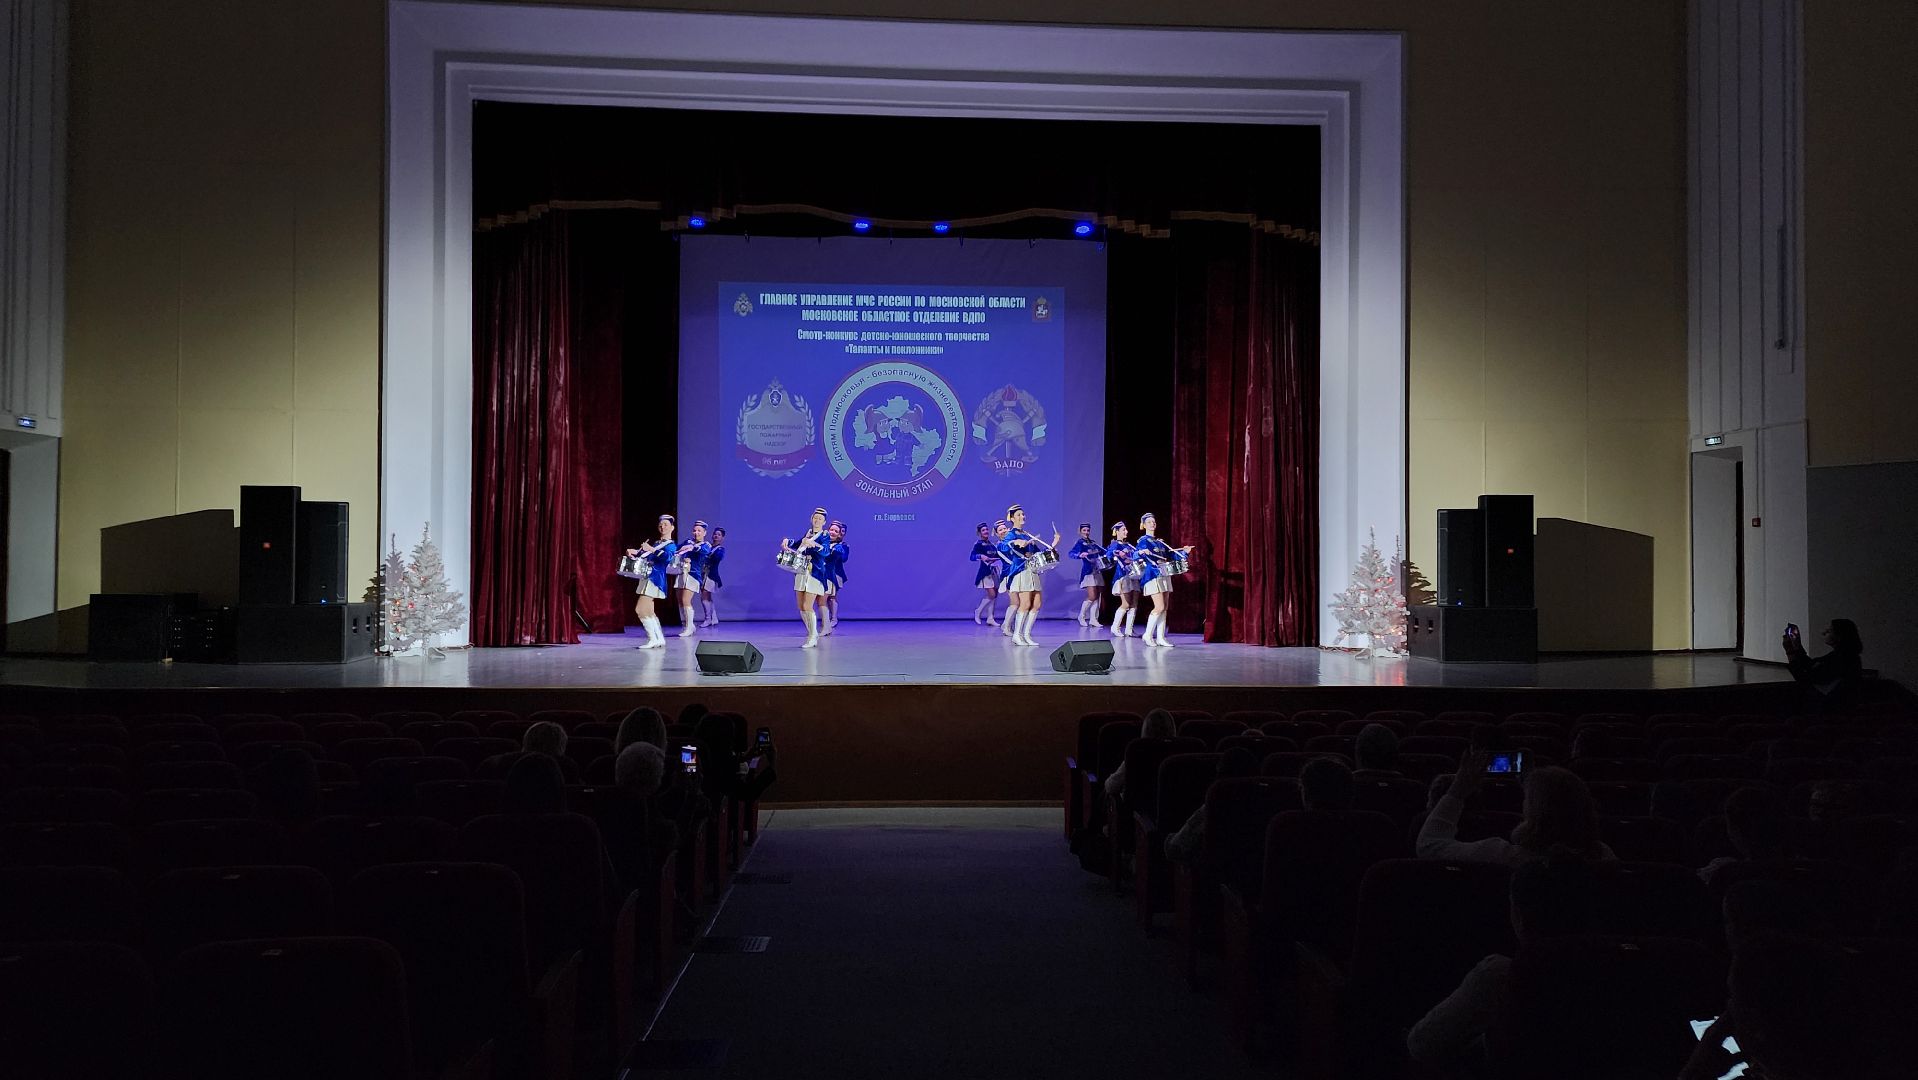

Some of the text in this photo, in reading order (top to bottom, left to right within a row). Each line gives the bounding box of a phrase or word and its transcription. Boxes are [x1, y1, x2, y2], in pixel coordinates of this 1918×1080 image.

[760, 293, 1026, 308] ГЛАВНОЕ УПРАВЛЕНИЕ МЧС РОССИИ ПО МОСКОВСКОЙ ОБЛАСТИ
[801, 309, 986, 324] МОСКОВСКОЕ ОБЛАСТНОЕ ОТДЕЛЕНИЕ ВДПО
[797, 328, 990, 342] Смотр-конкурс детско-юношеского творчества
[884, 345, 891, 354] и
[871, 369, 927, 383] безопасную
[829, 377, 866, 431] Подмосковья
[928, 381, 958, 463] жизнедеятельность
[830, 433, 844, 462] Детям
[994, 459, 1024, 469] ВДПО
[855, 479, 934, 499] ЗОНАЛЬНЫЙ ЭТАП
